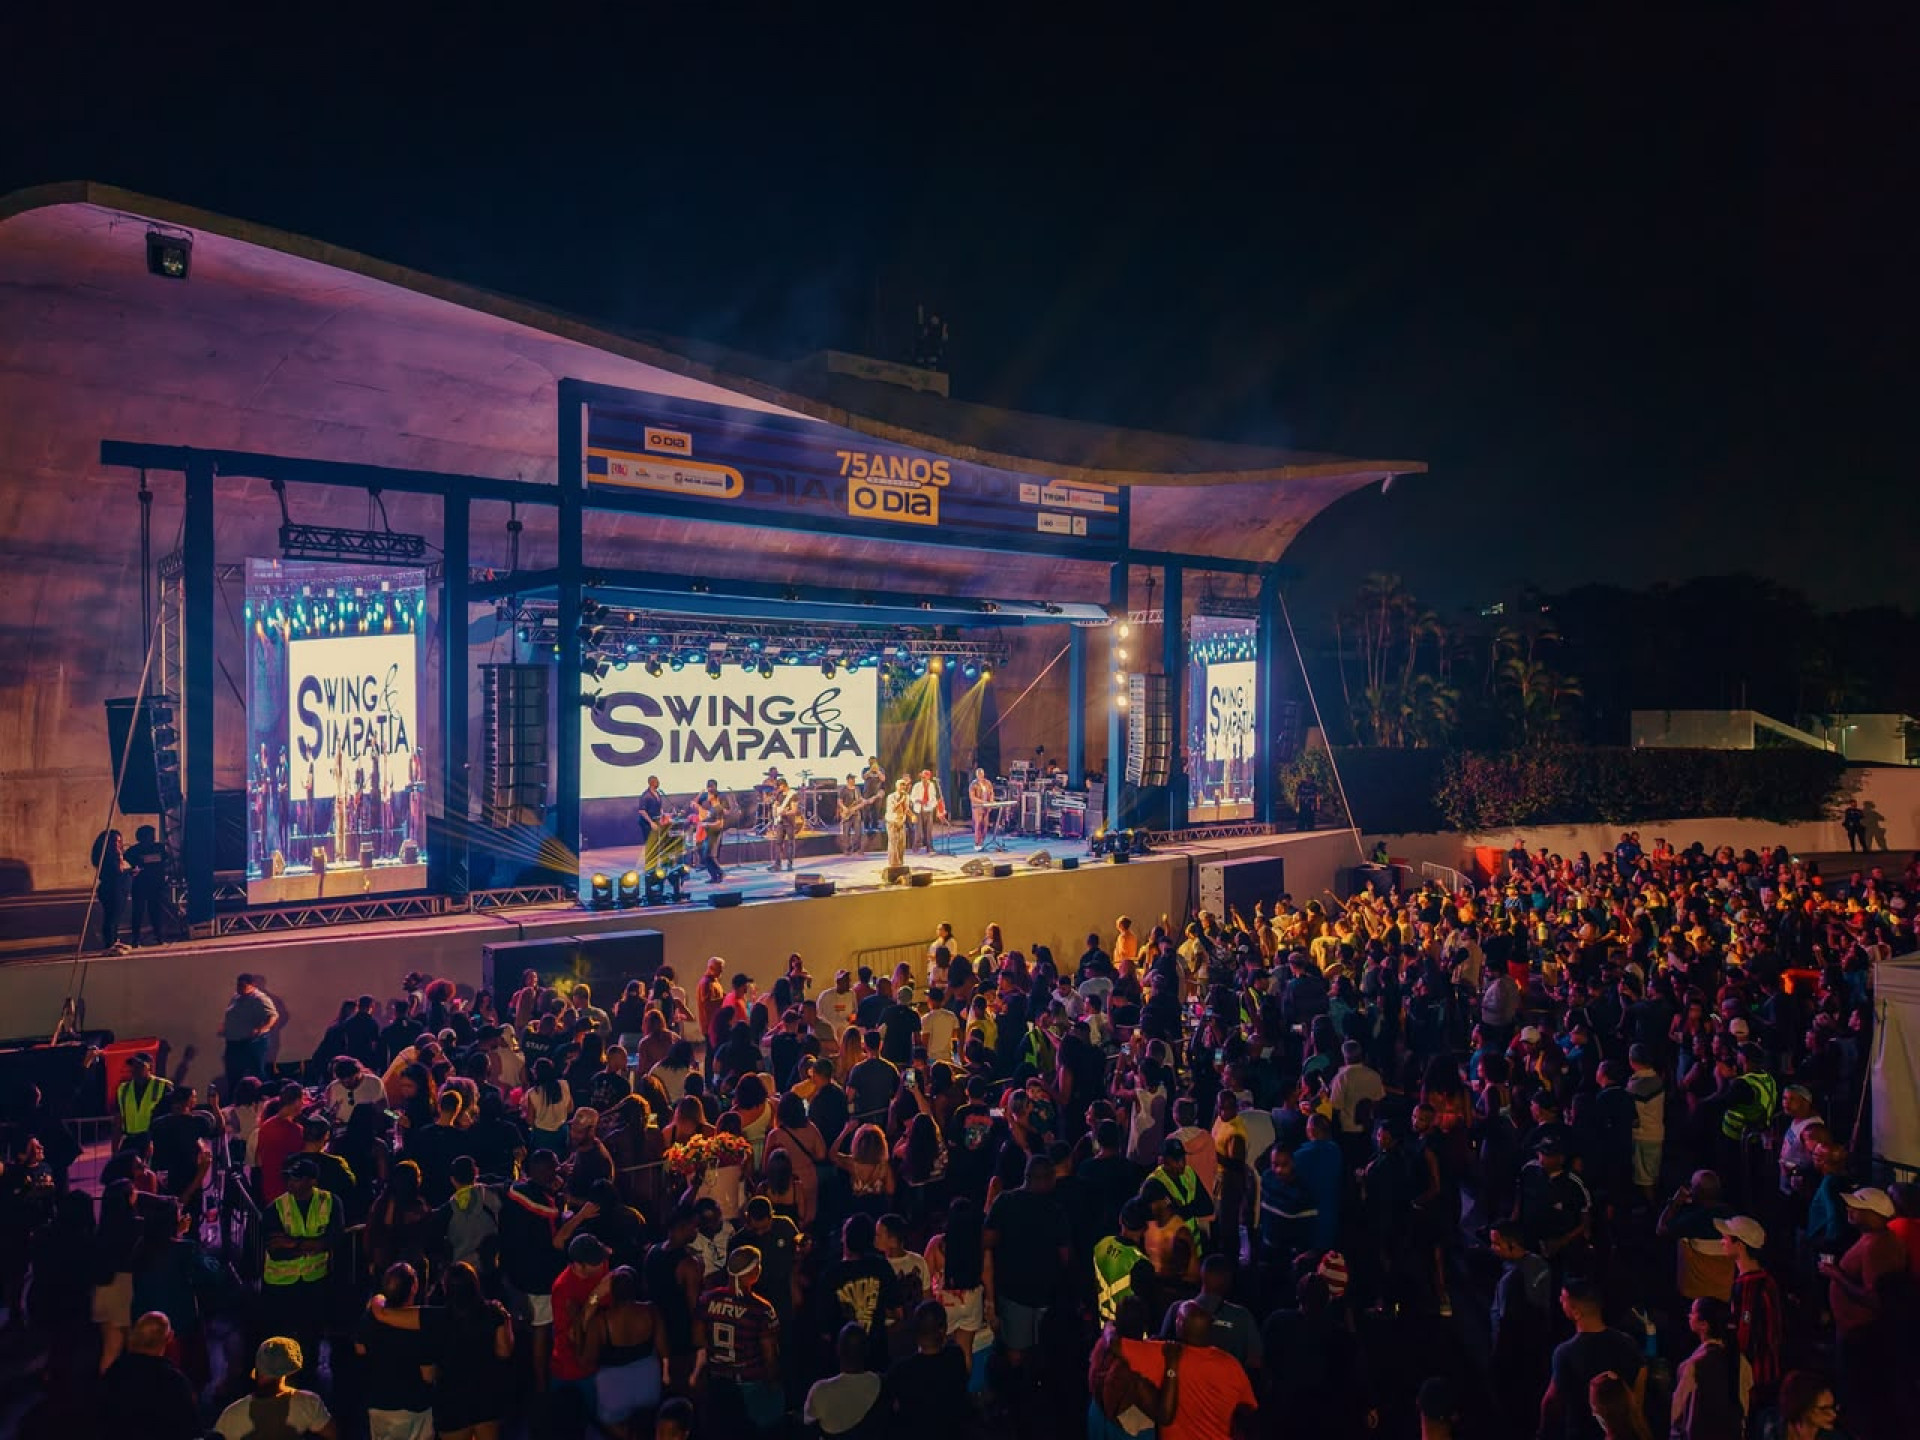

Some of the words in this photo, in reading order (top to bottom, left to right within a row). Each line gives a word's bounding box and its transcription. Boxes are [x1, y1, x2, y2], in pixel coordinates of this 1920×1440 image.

[854, 487, 877, 510] O
[525, 1041, 550, 1051] STAFF
[708, 1301, 747, 1319] MRV
[709, 1322, 735, 1362] 9
